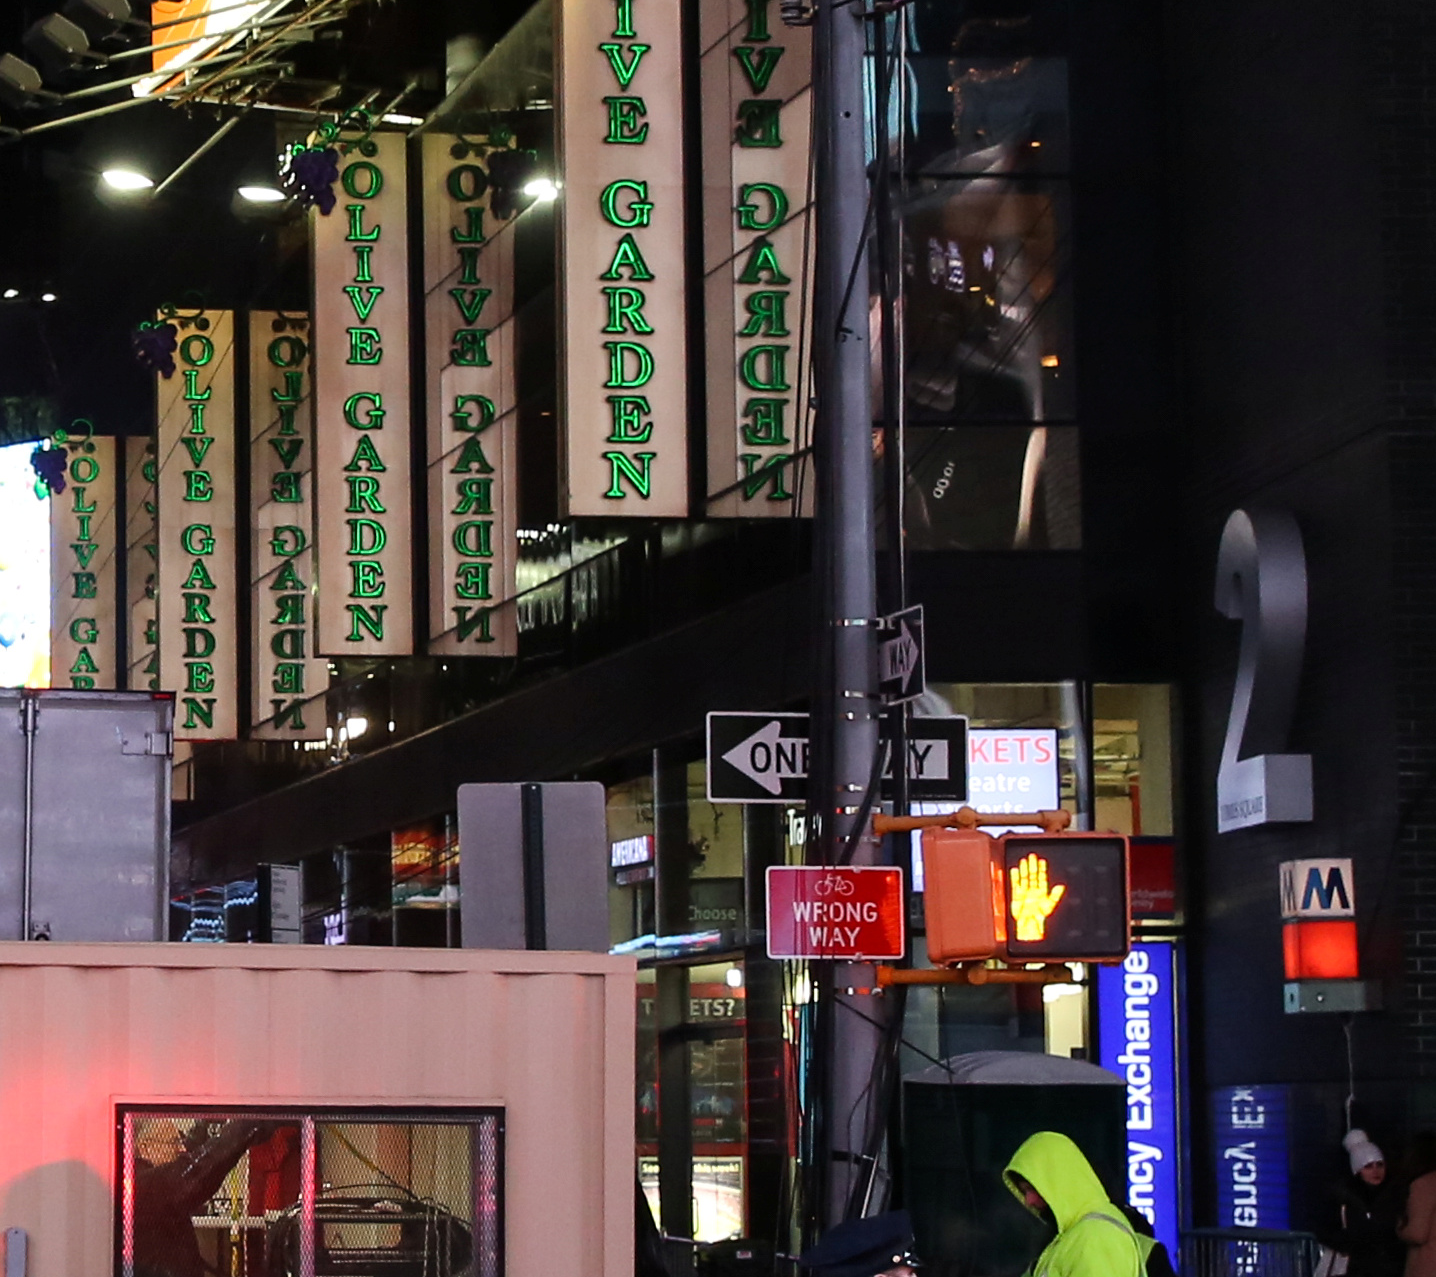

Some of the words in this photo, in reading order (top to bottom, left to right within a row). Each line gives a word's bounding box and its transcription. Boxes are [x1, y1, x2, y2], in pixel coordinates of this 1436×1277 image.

[342, 161, 384, 366] OLIVE
[598, 179, 654, 499] GARDEN
[181, 334, 213, 504] OLIVE
[69, 457, 98, 600] OLIVE
[344, 391, 388, 643] GARDEN
[68, 617, 100, 690] GAR
[182, 521, 215, 730] GARDEN
[969, 736, 1054, 765] KETS
[969, 774, 1032, 794] eatre
[792, 901, 879, 924] WRONG
[809, 926, 861, 949] WAY
[1117, 948, 1160, 1131] Exchange
